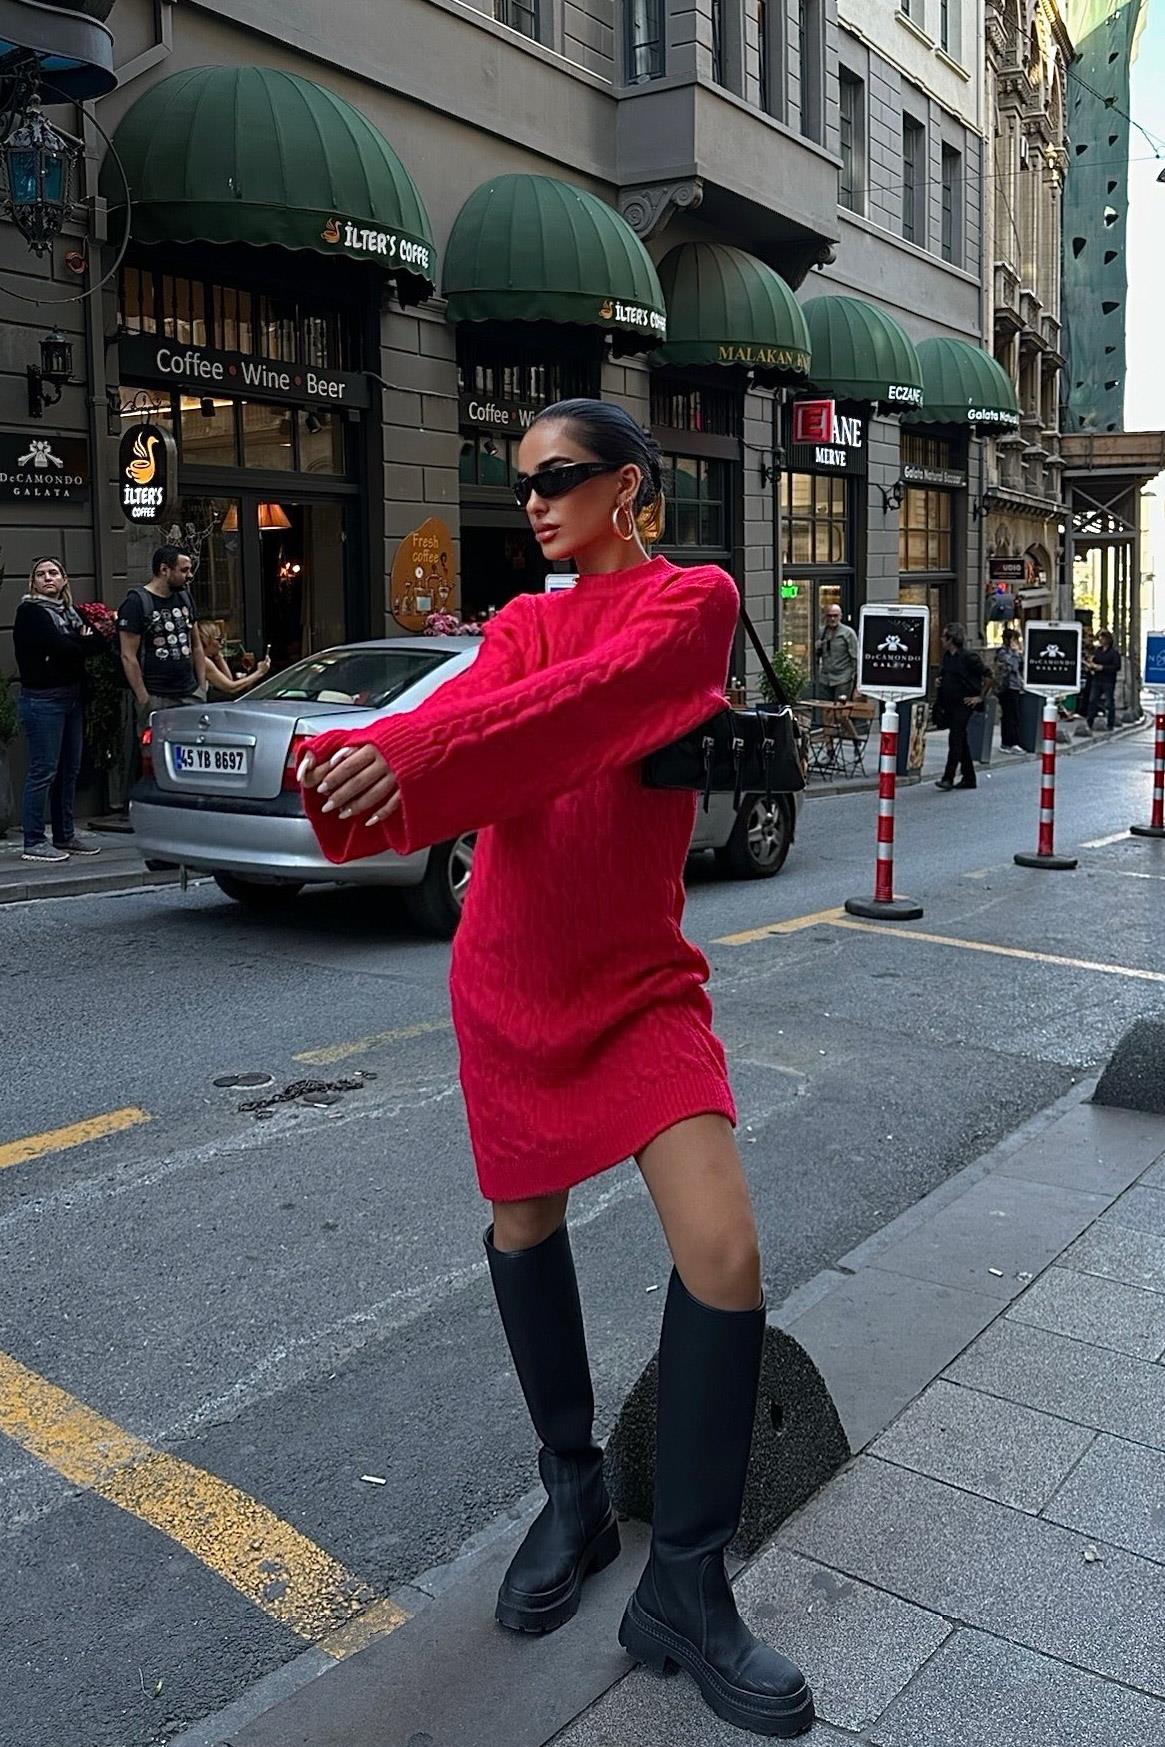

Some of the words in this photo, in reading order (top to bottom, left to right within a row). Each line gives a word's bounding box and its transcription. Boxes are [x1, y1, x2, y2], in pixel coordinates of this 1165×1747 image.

[344, 221, 397, 256] İLTER'S
[614, 301, 648, 326] İLTER'S
[719, 346, 793, 364] MALAKAN
[156, 348, 223, 380] Coffee
[241, 361, 290, 390] Wine
[306, 372, 346, 398] Beer
[888, 385, 921, 403] ECZANE
[468, 401, 509, 424] Coffee
[518, 408, 536, 427] Wi
[967, 408, 999, 421] Galata
[831, 414, 862, 448] ANE
[815, 446, 847, 467] MERVE
[0, 473, 83, 485] DeCAMONDO
[13, 487, 70, 497] GALATA
[123, 484, 163, 505] İLTER'S
[412, 533, 439, 548] Fresh
[412, 549, 440, 563] coffee
[181, 749, 194, 768] 45
[197, 750, 211, 769] YB
[214, 751, 244, 771] 8697
